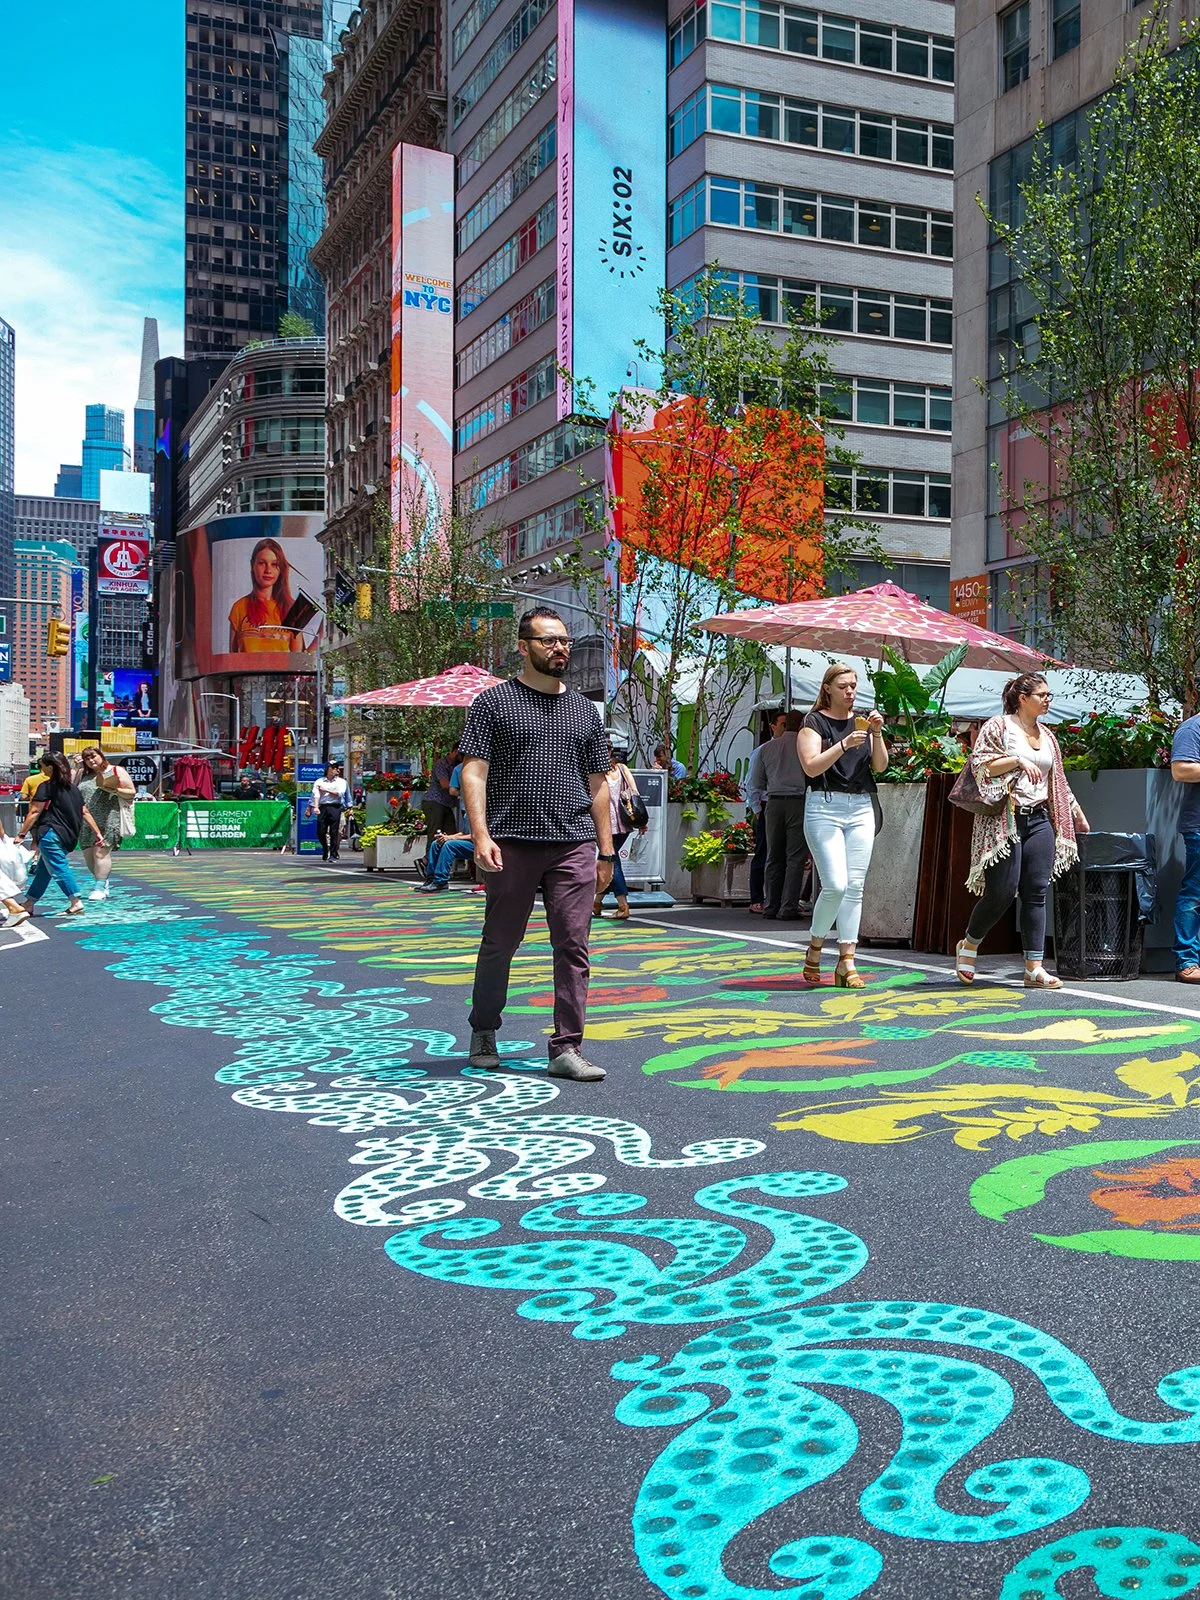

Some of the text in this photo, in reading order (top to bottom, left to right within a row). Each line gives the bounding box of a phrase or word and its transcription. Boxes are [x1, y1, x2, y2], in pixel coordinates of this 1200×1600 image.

[613, 166, 632, 257] SIX:02
[404, 273, 451, 288] WELCOME
[422, 284, 435, 294] TO
[403, 289, 452, 314] NYC
[954, 581, 980, 598] 1450
[127, 758, 146, 766] IT'S
[126, 766, 154, 774] ESIGN
[131, 774, 147, 782] EEK
